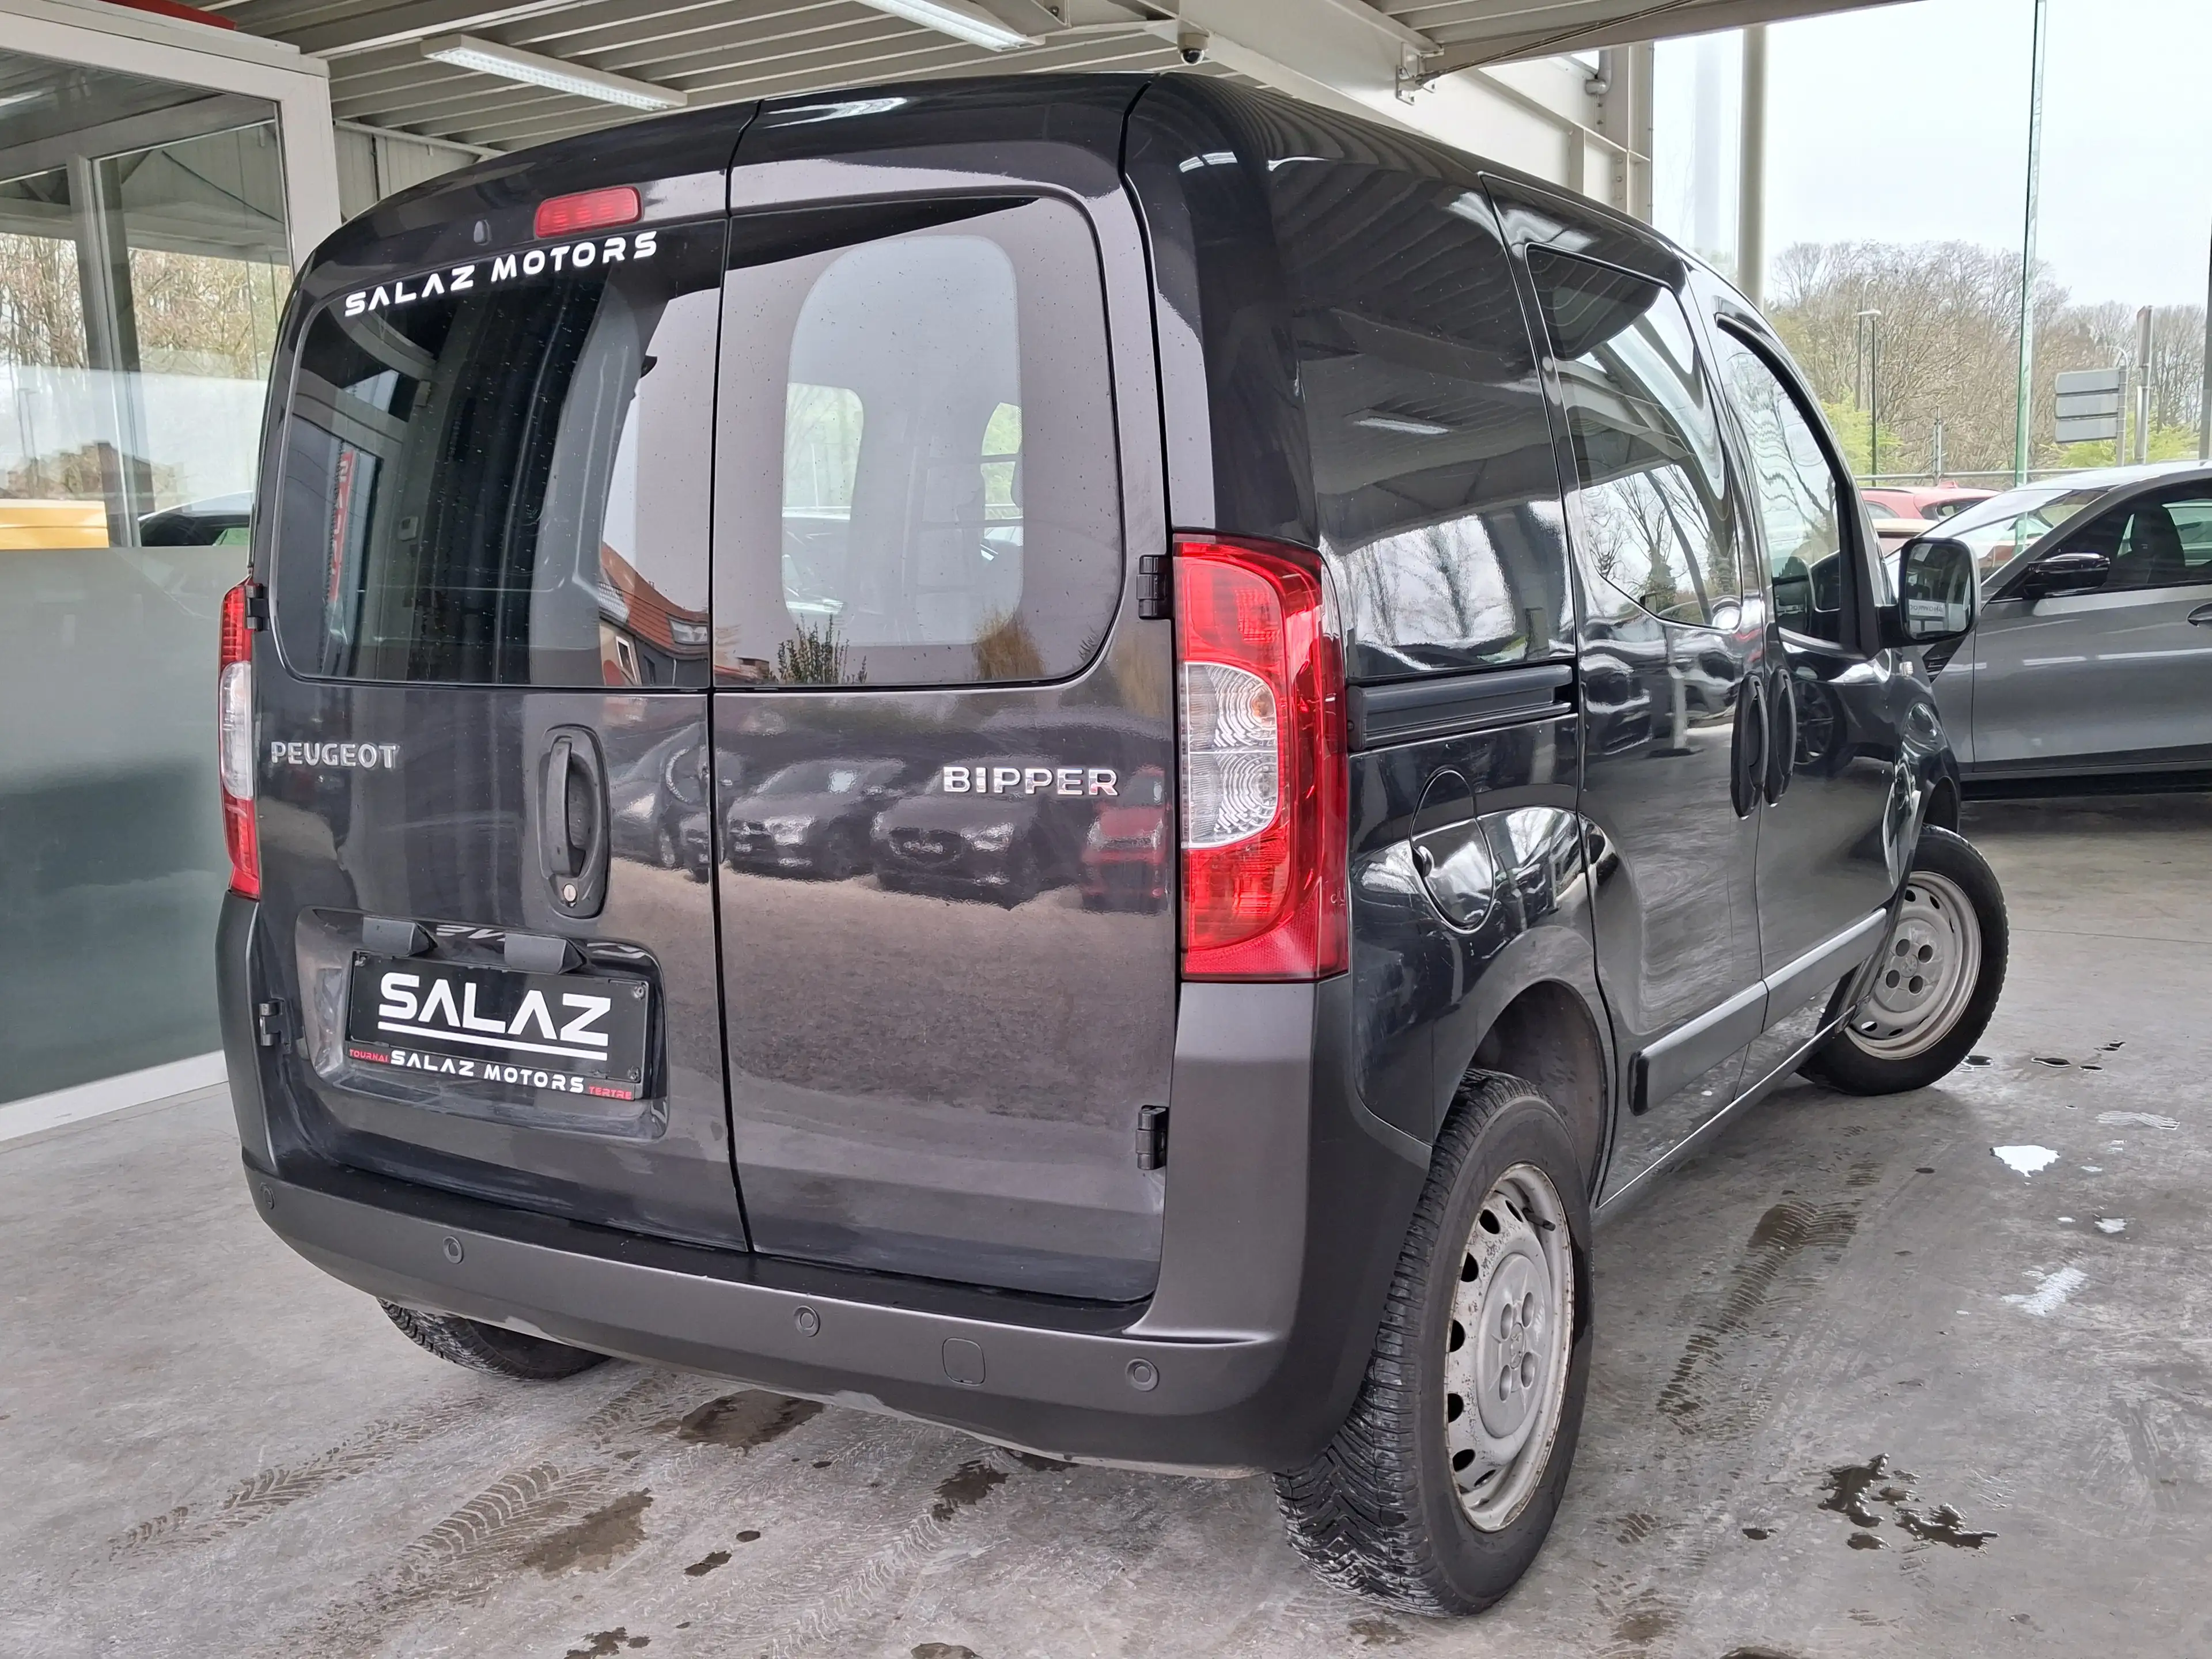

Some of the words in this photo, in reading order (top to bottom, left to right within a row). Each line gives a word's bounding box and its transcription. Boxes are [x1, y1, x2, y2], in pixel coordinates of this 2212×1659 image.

[344, 264, 475, 317] SALAZ
[491, 231, 657, 282] MOTORS
[271, 741, 400, 770] PEUGEOT
[943, 766, 1119, 796] BIPPER
[378, 972, 611, 1047] SALAZ
[349, 1048, 389, 1063] TOURNAI
[390, 1050, 475, 1077] SALAZ
[483, 1063, 584, 1093] MOTORS
[589, 1085, 632, 1100] TERTRE
